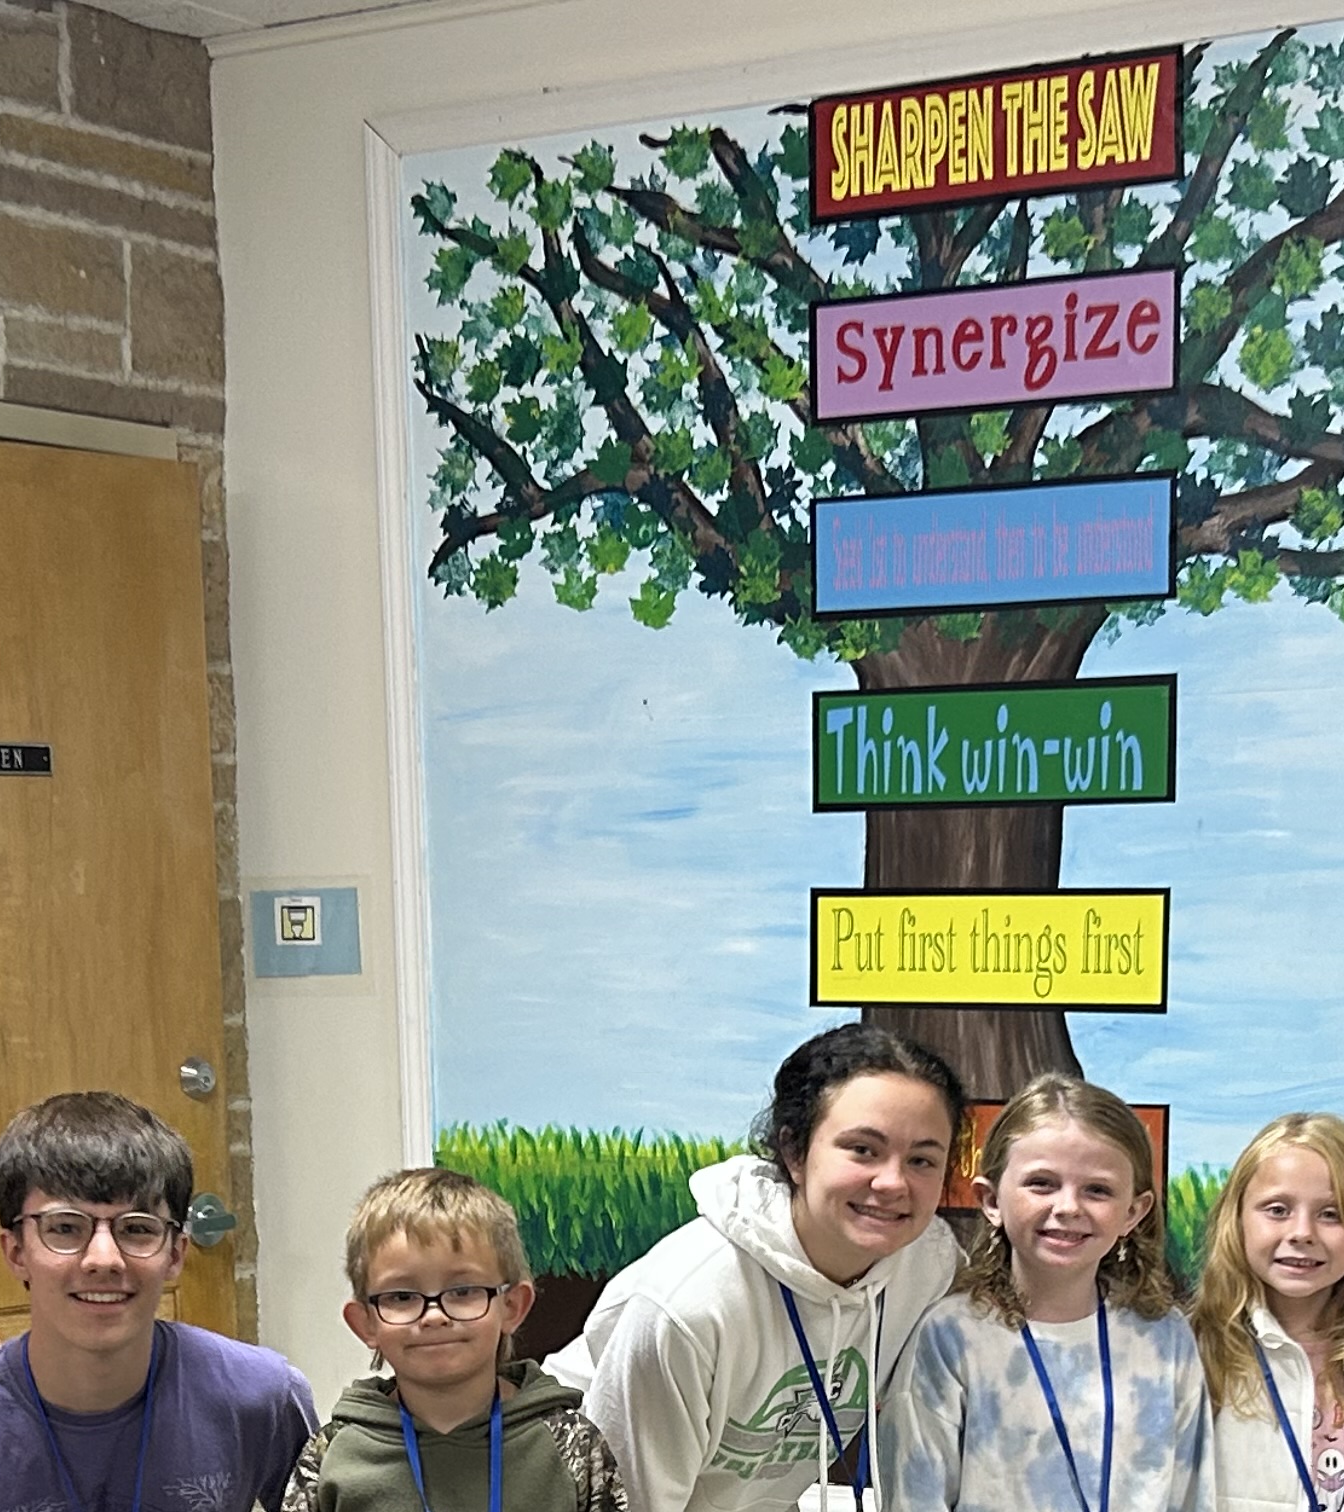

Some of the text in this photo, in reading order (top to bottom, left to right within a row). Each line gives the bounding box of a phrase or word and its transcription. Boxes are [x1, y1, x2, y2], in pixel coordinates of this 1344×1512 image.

[831, 63, 1159, 201] SHARPEN THE SAW
[836, 292, 1161, 391] Synergize
[826, 701, 1143, 795] Think win-win
[831, 907, 1145, 998] Put first things first
